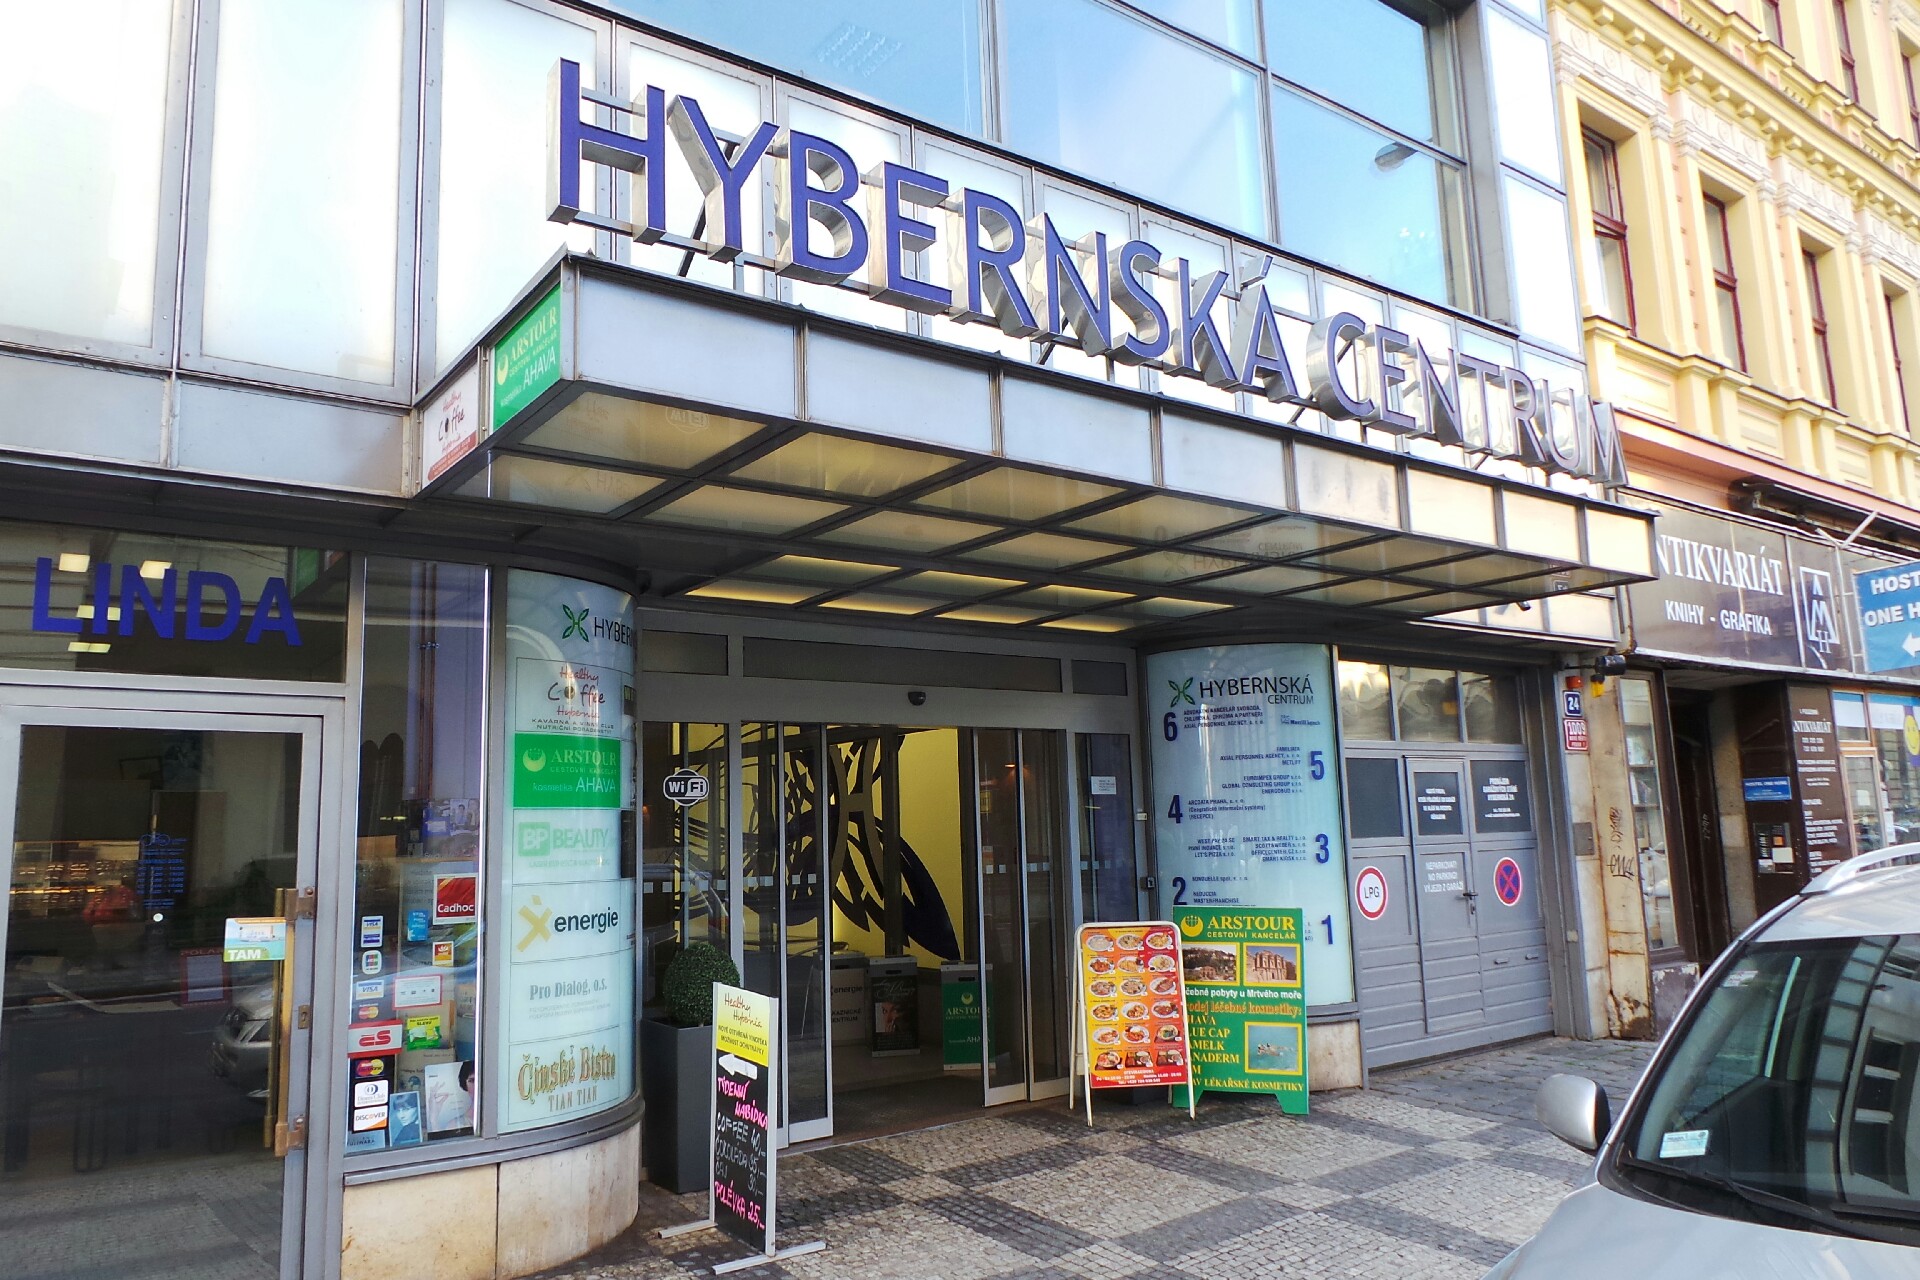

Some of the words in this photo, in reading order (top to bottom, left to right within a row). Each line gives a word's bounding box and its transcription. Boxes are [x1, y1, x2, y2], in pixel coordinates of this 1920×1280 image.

[548, 57, 1299, 402] HYBERNSKÁ
[1307, 311, 1630, 488] CENTRUM
[510, 306, 557, 362] ARSTOUR
[522, 345, 556, 390] AHAVA
[32, 557, 303, 647] LINDA
[1665, 600, 1704, 625] KNIHY
[1720, 609, 1772, 636] GRAFIKA
[1864, 604, 1904, 627] ONE
[559, 666, 600, 686] Healthy
[1200, 673, 1314, 699] HYBERNSKÁ
[548, 682, 606, 708] Coffee
[1267, 694, 1314, 705] CENTRUM
[1568, 697, 1579, 710] 24
[1163, 711, 1178, 742] 6
[1568, 721, 1586, 735] 1009
[550, 749, 617, 766] ARSTOUR
[1310, 750, 1325, 781] 5
[576, 776, 617, 793] AHAVA
[1167, 794, 1183, 824] 4
[523, 828, 549, 850] BP
[552, 828, 609, 849] BEAUTY
[1315, 833, 1330, 864] 3
[1172, 876, 1187, 905] 2
[1364, 886, 1380, 899] LPG
[438, 903, 475, 914] Cadhoc
[554, 907, 618, 934] energie
[1207, 915, 1296, 931] ARSTOUR
[1207, 930, 1247, 939] CESTOVNÍ
[1251, 931, 1296, 940] KANCELÁŘ
[1321, 914, 1333, 945] 1
[228, 949, 261, 960] TAM
[529, 984, 551, 1001] Pro
[724, 992, 751, 1017] Healthy
[1210, 988, 1238, 999] pobyty
[1239, 990, 1246, 998] u
[1246, 988, 1279, 999] Mrtvého
[1280, 989, 1302, 1000] moře
[733, 1009, 763, 1028] Hybernia
[1211, 1001, 1247, 1014] léčebné
[1248, 1002, 1303, 1019] kosmetiky:
[1189, 1026, 1206, 1038] UE
[1208, 1027, 1231, 1039] CAP
[718, 1075, 751, 1101] TÝDENNÍ
[1204, 1077, 1250, 1089] LÉKAŘSKÉ
[1251, 1080, 1304, 1092] KOSMETIKY
[548, 1090, 573, 1113] TIAN
[577, 1085, 597, 1106] TIAN
[355, 1111, 386, 1122] DISCOVER
[735, 1099, 768, 1130] NABÍDKA
[717, 1112, 749, 1143] COFFEE
[715, 1180, 746, 1219] POLÉVKA
